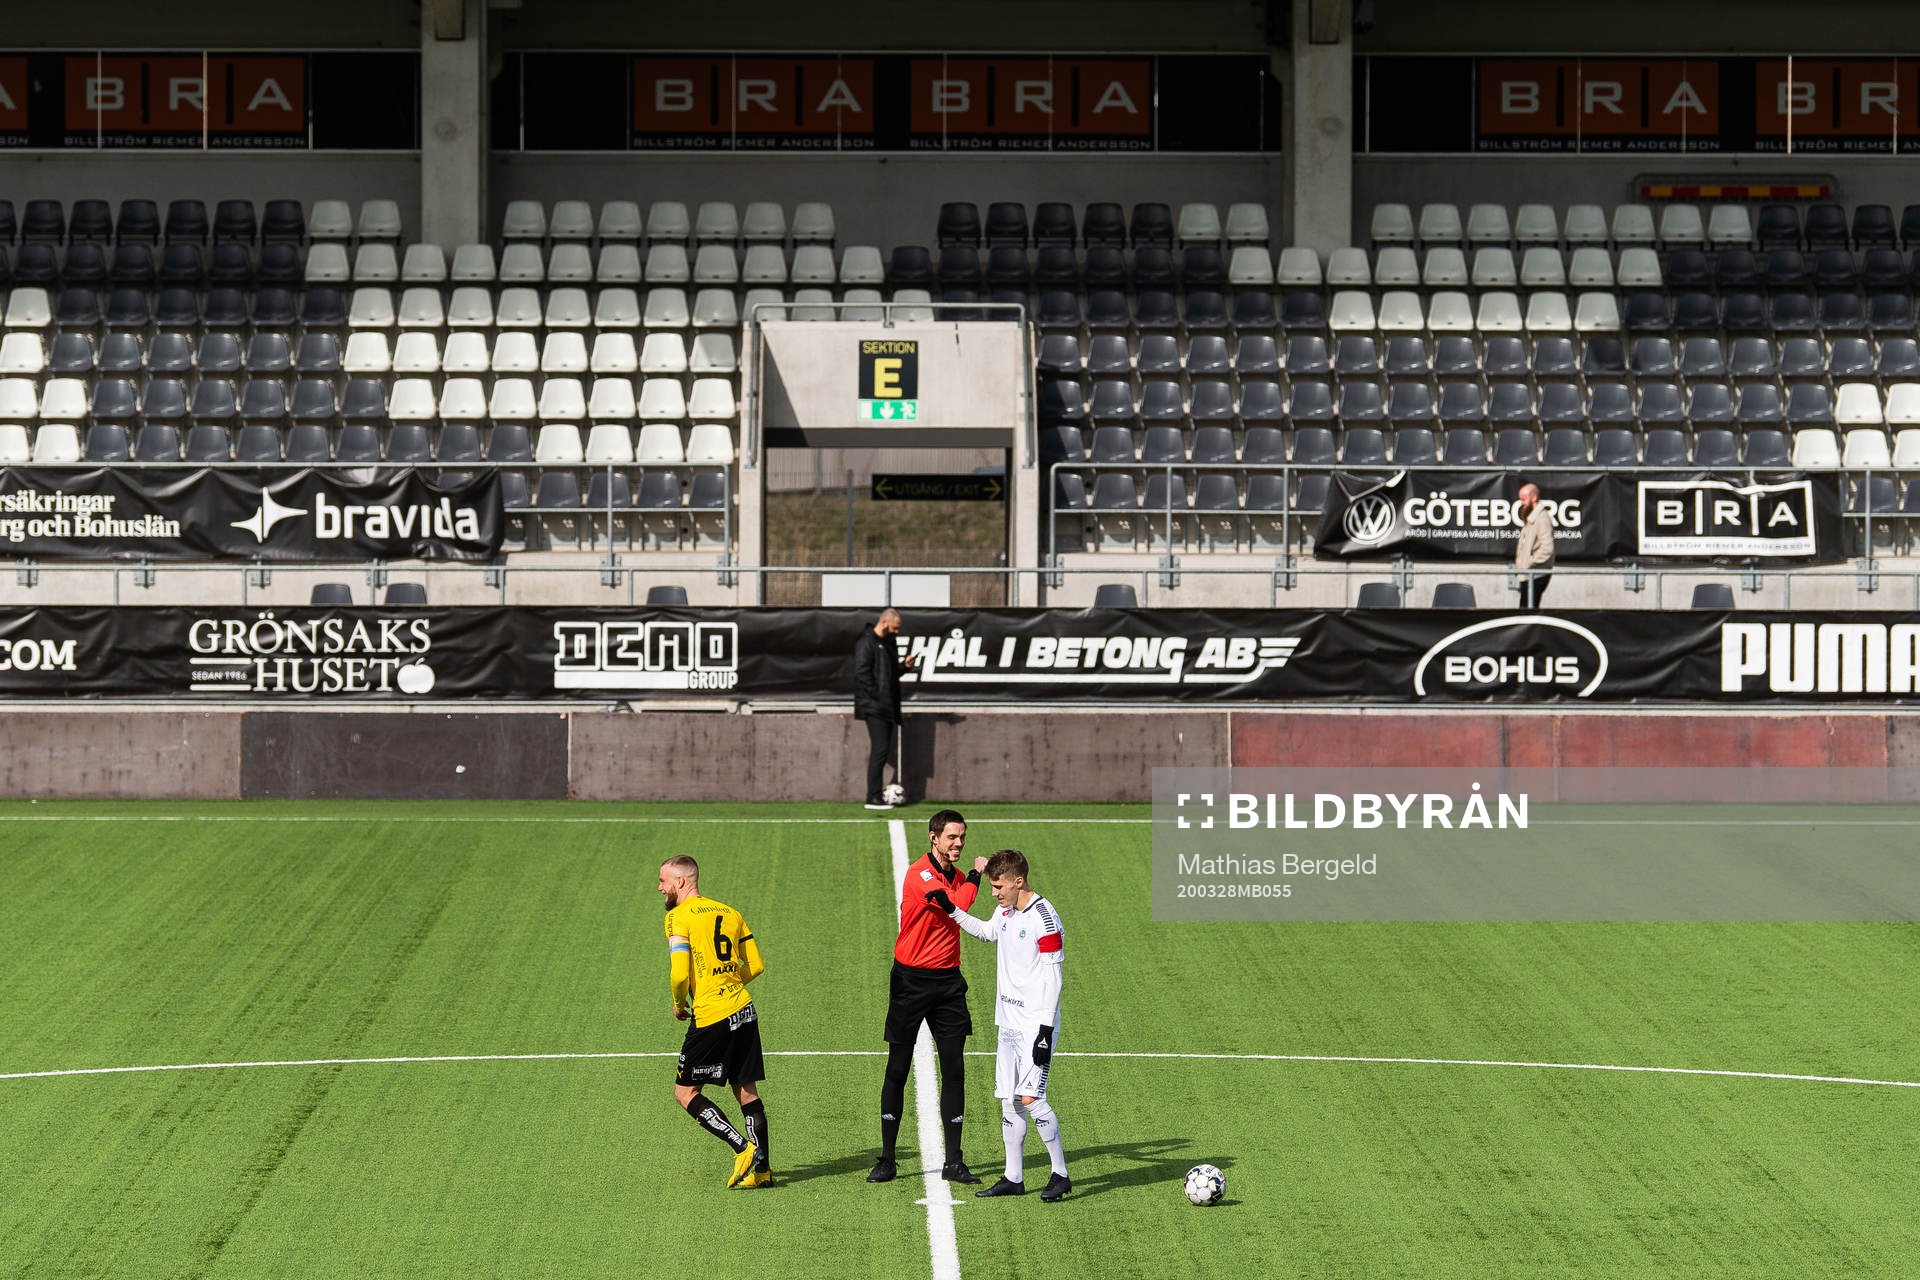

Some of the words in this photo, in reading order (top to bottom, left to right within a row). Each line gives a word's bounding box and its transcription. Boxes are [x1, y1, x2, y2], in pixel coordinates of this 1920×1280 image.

[722, 137, 777, 147] REMER
[1567, 139, 1622, 149] REMER
[862, 341, 916, 354] SEKTION
[874, 358, 903, 398] E
[28, 514, 71, 538] och
[73, 514, 182, 538] Bohuslän
[315, 492, 481, 540] bravida
[188, 611, 432, 655] GRÖNSAKS
[998, 636, 1017, 668] I
[1025, 636, 1188, 683] BETONG
[1444, 655, 1580, 684] BOHUS
[1721, 622, 1920, 693] PUMA
[191, 671, 222, 681] SEDAN
[252, 657, 401, 692] HUSET
[688, 672, 739, 690] GROUP
[713, 915, 732, 961] 6
